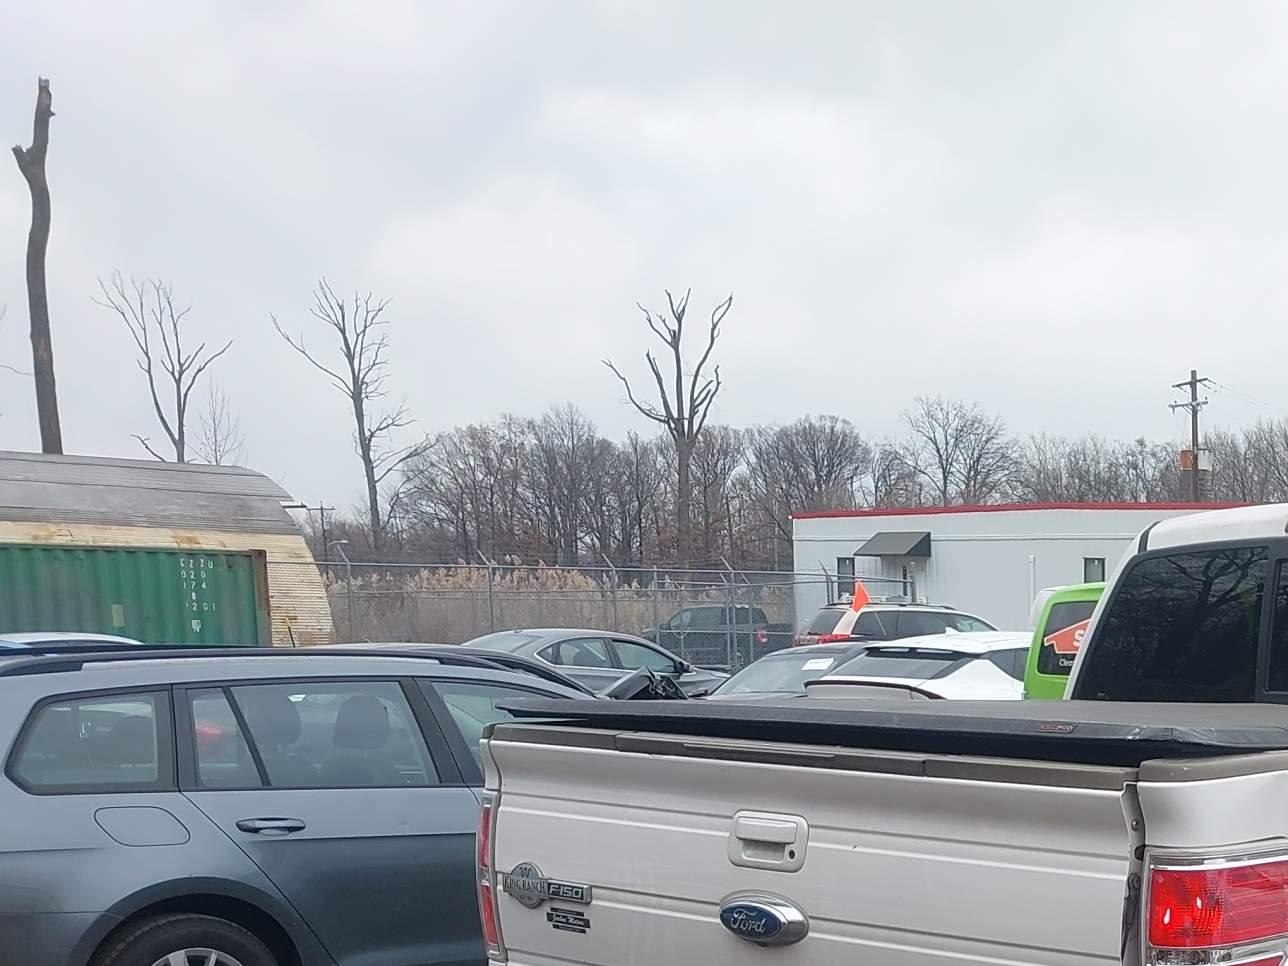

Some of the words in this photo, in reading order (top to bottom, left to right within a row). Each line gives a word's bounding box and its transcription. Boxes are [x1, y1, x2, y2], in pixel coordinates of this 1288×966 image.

[504, 874, 521, 890] KING
[521, 878, 546, 894] RANCH
[731, 908, 767, 933] Ford
